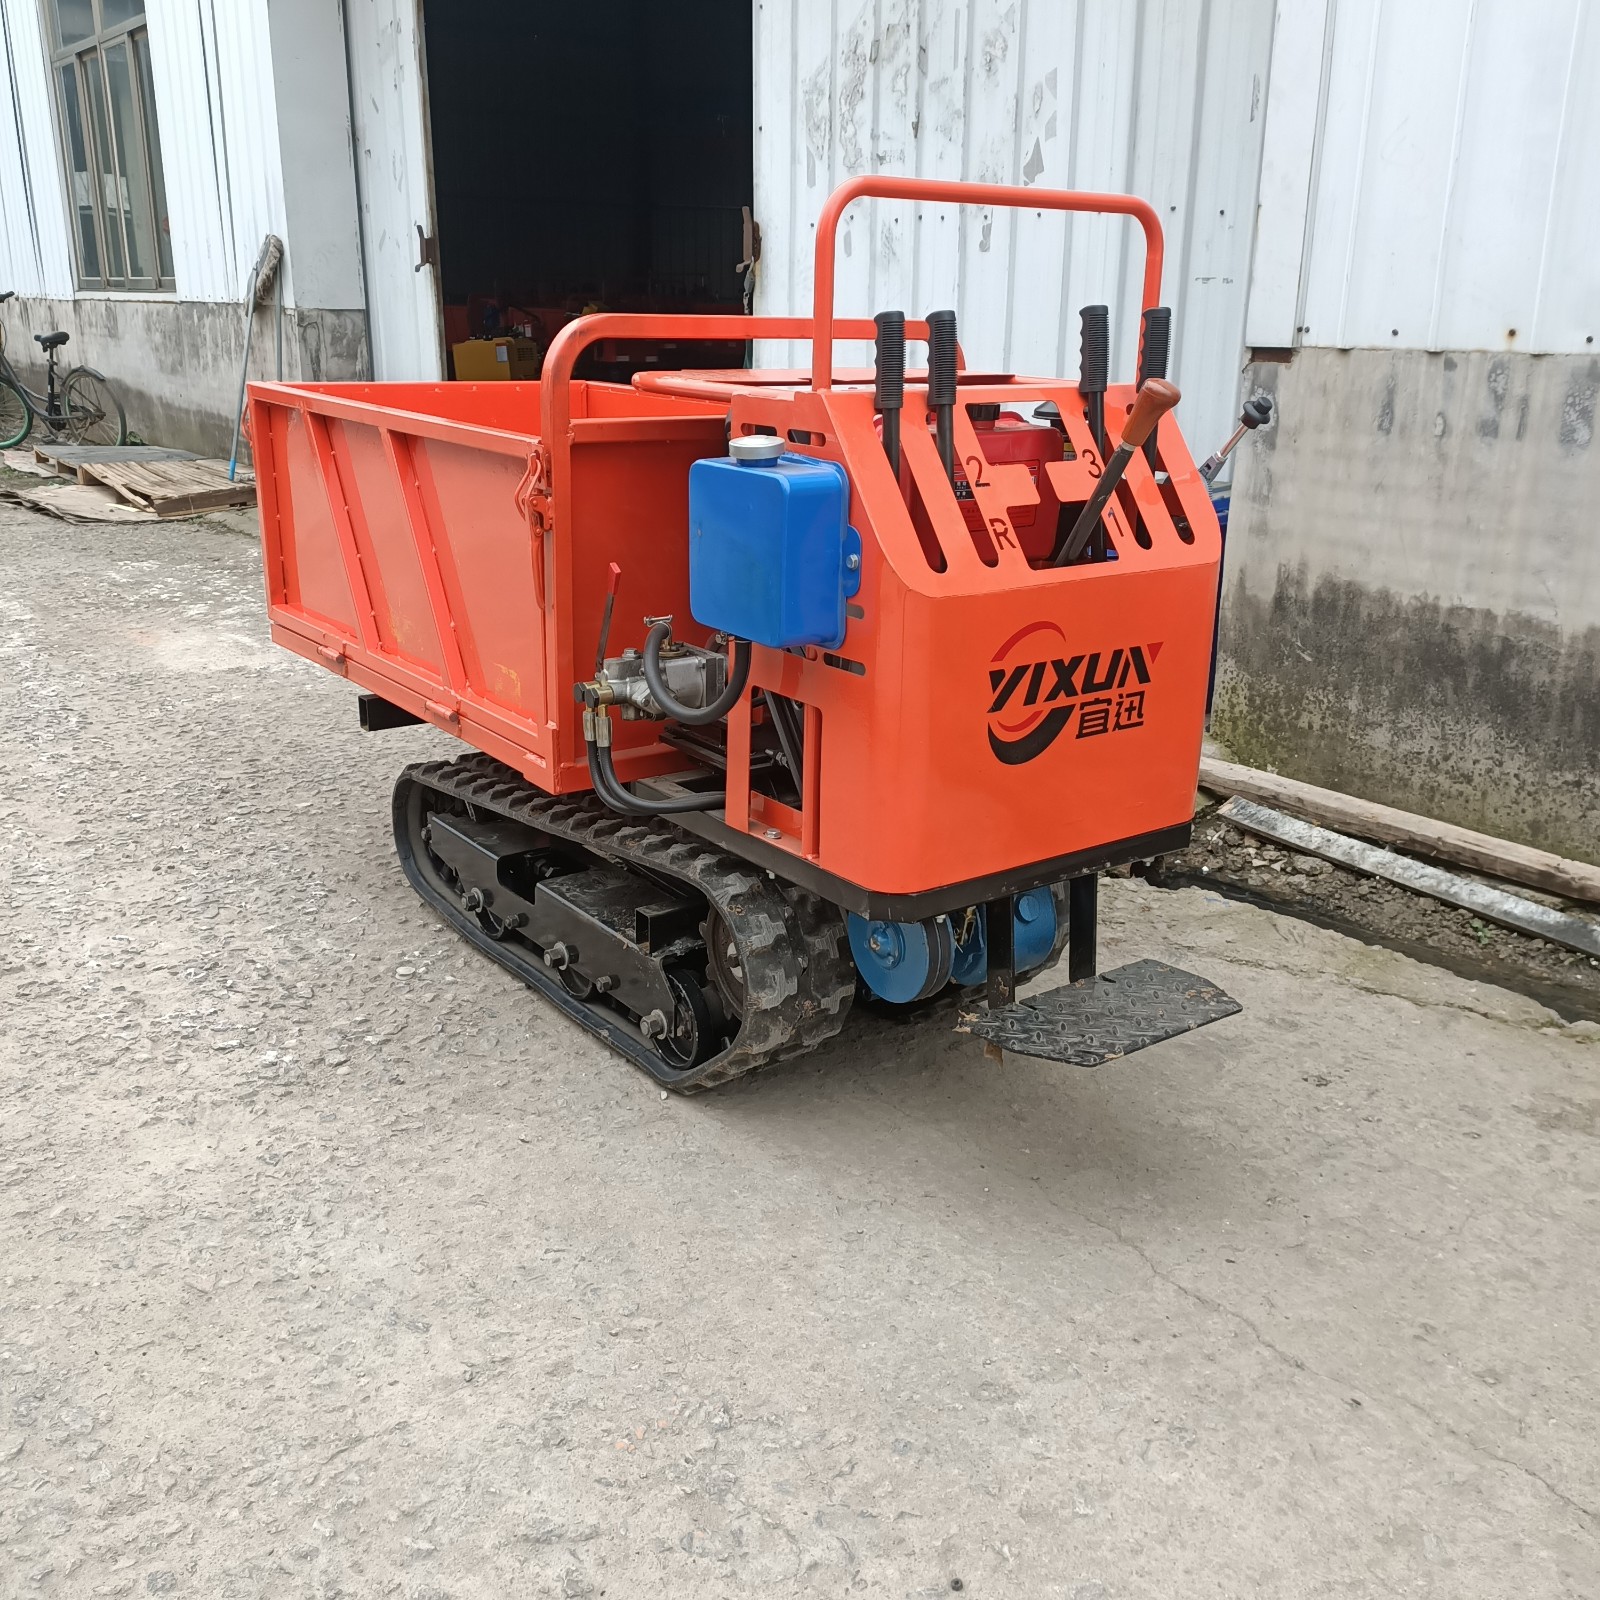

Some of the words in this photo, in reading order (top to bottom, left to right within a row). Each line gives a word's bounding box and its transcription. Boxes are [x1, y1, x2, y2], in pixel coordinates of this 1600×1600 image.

[965, 455, 991, 488] 2
[1082, 448, 1103, 479] 3
[988, 518, 1017, 550] R
[1107, 506, 1125, 538] 1
[1075, 690, 1145, 739] 宜迅
